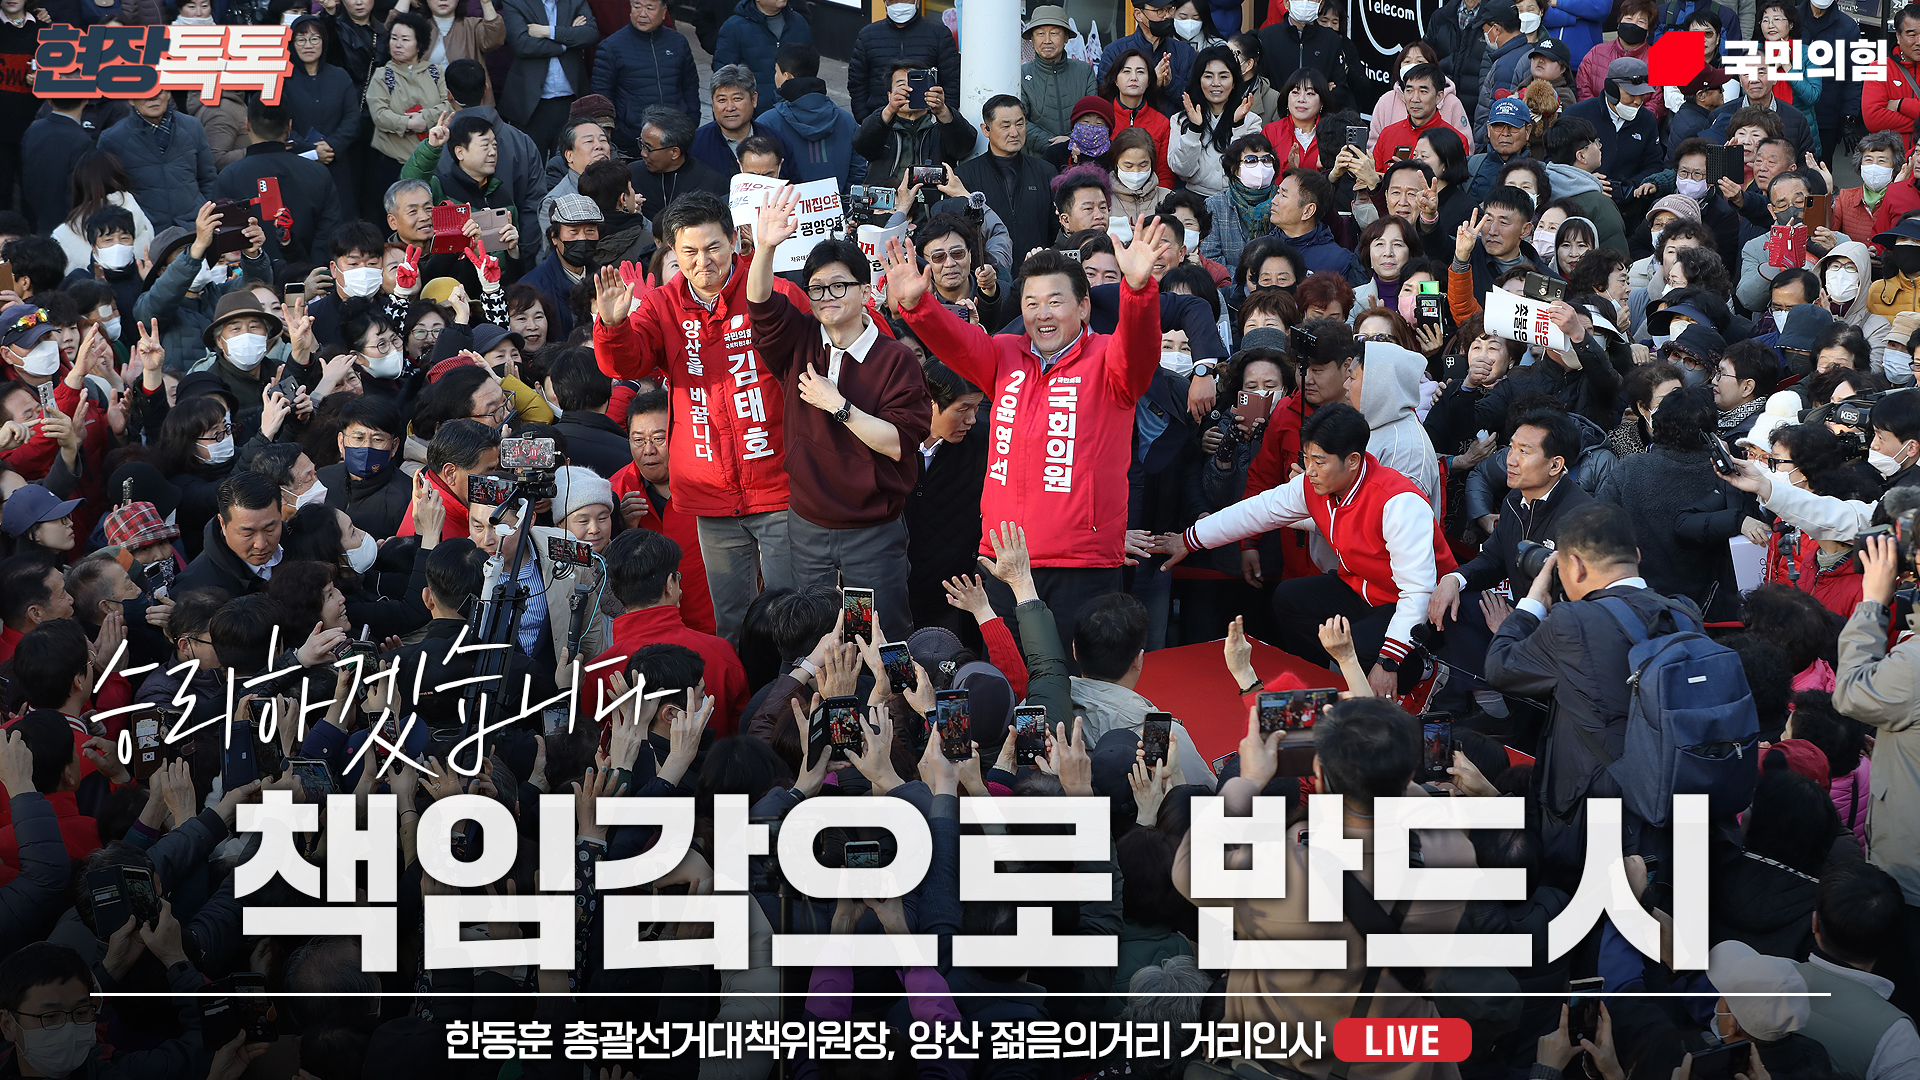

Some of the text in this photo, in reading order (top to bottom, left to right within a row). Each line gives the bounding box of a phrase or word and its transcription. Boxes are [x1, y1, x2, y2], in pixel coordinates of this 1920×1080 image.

[1360, 60, 1390, 84] ince
[799, 194, 840, 214] 개집으로
[1513, 303, 1529, 342] 촛불은
[682, 319, 713, 462] 양산을 바꿉니다
[728, 350, 775, 461] 김태호
[1840, 410, 1858, 422] KBS
[1042, 386, 1078, 493] 국회의원
